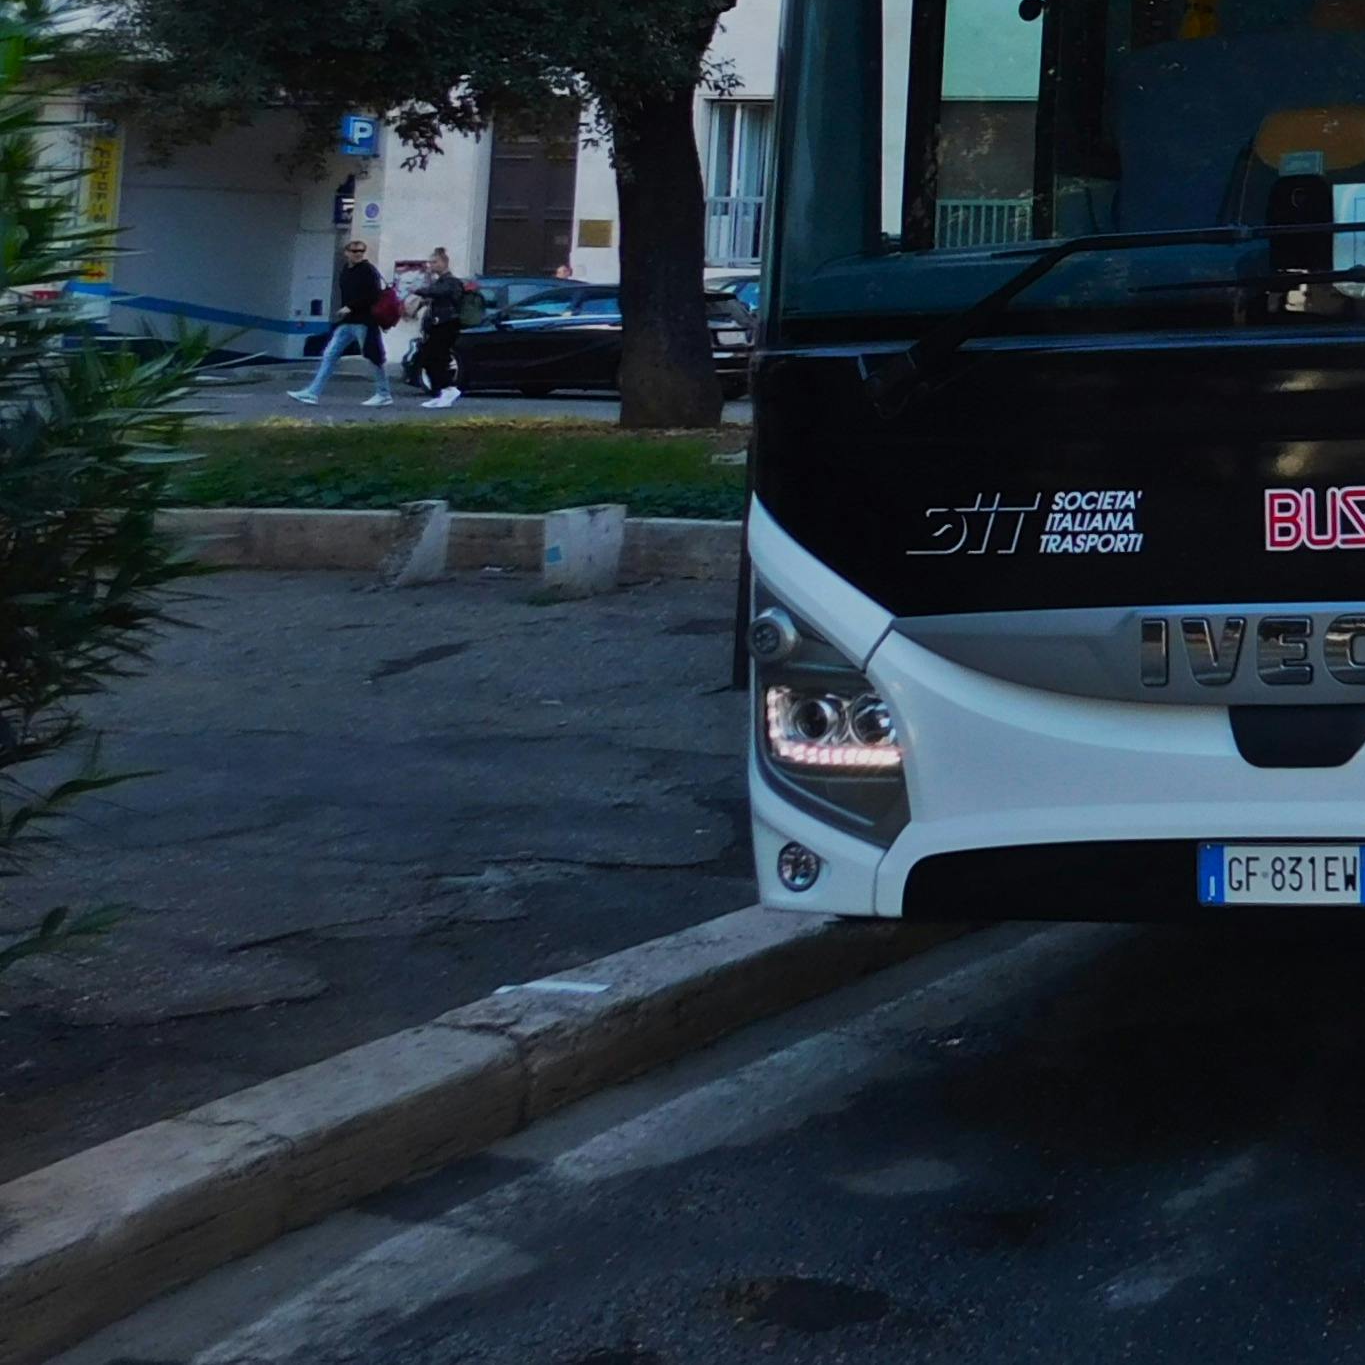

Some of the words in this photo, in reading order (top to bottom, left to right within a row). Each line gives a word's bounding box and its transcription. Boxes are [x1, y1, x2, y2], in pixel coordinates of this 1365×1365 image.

[353, 121, 374, 145] P
[1051, 490, 1143, 511] SOCIETA'
[1044, 512, 1135, 532] ITALIANA
[1038, 533, 1144, 554] TRASPORTI
